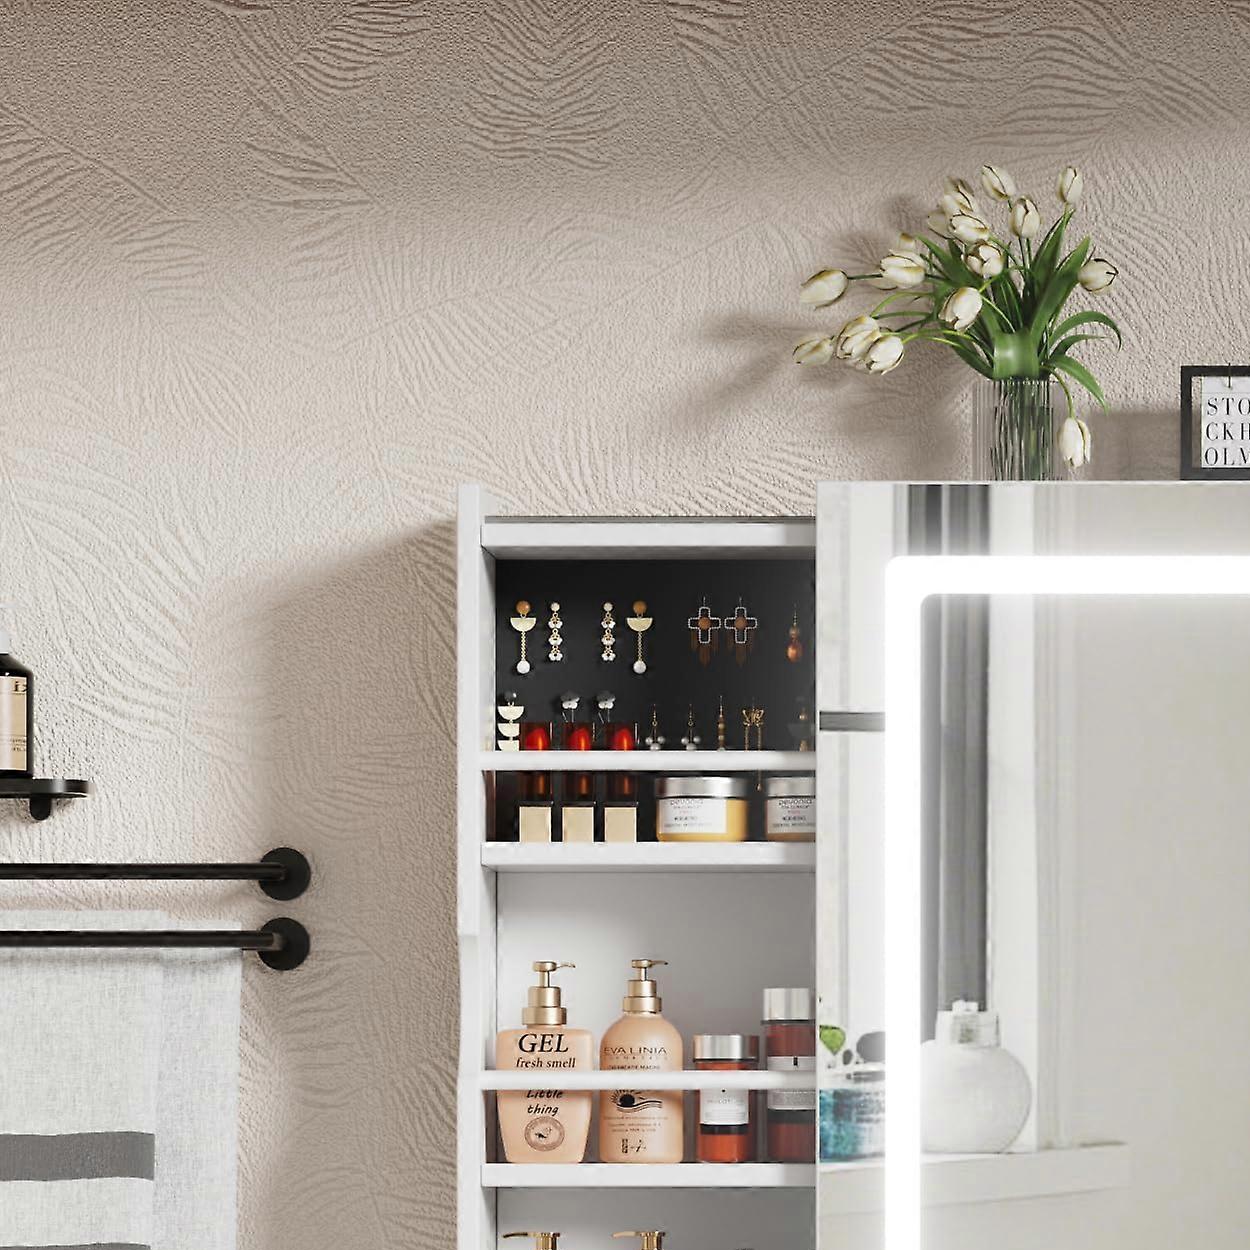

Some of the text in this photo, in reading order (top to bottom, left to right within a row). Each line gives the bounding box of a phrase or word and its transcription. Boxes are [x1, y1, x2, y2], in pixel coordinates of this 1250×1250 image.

[518, 1033, 569, 1053] GEL
[516, 1057, 576, 1069] fresh smell
[526, 1089, 564, 1099] Little
[527, 1104, 559, 1116] thing
